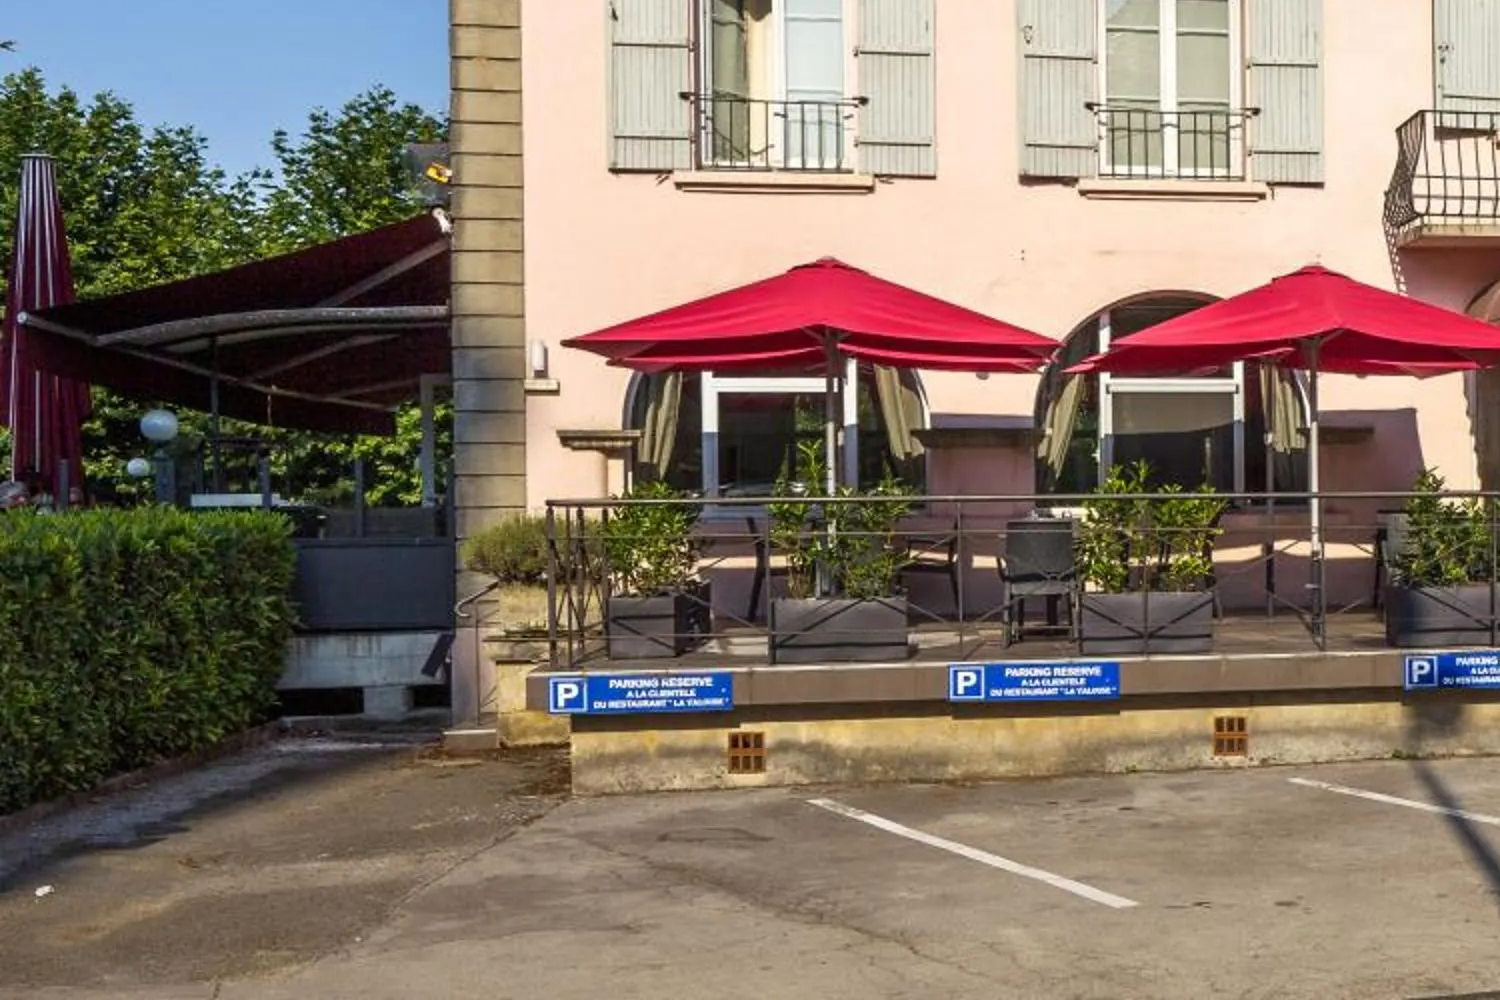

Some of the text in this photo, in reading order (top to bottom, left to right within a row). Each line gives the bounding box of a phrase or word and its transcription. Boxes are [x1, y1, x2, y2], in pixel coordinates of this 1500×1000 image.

[957, 671, 977, 695] P
[1005, 667, 1052, 677] PARKING
[1411, 660, 1431, 683] P
[608, 678, 659, 689] PARKING
[557, 683, 579, 708] P
